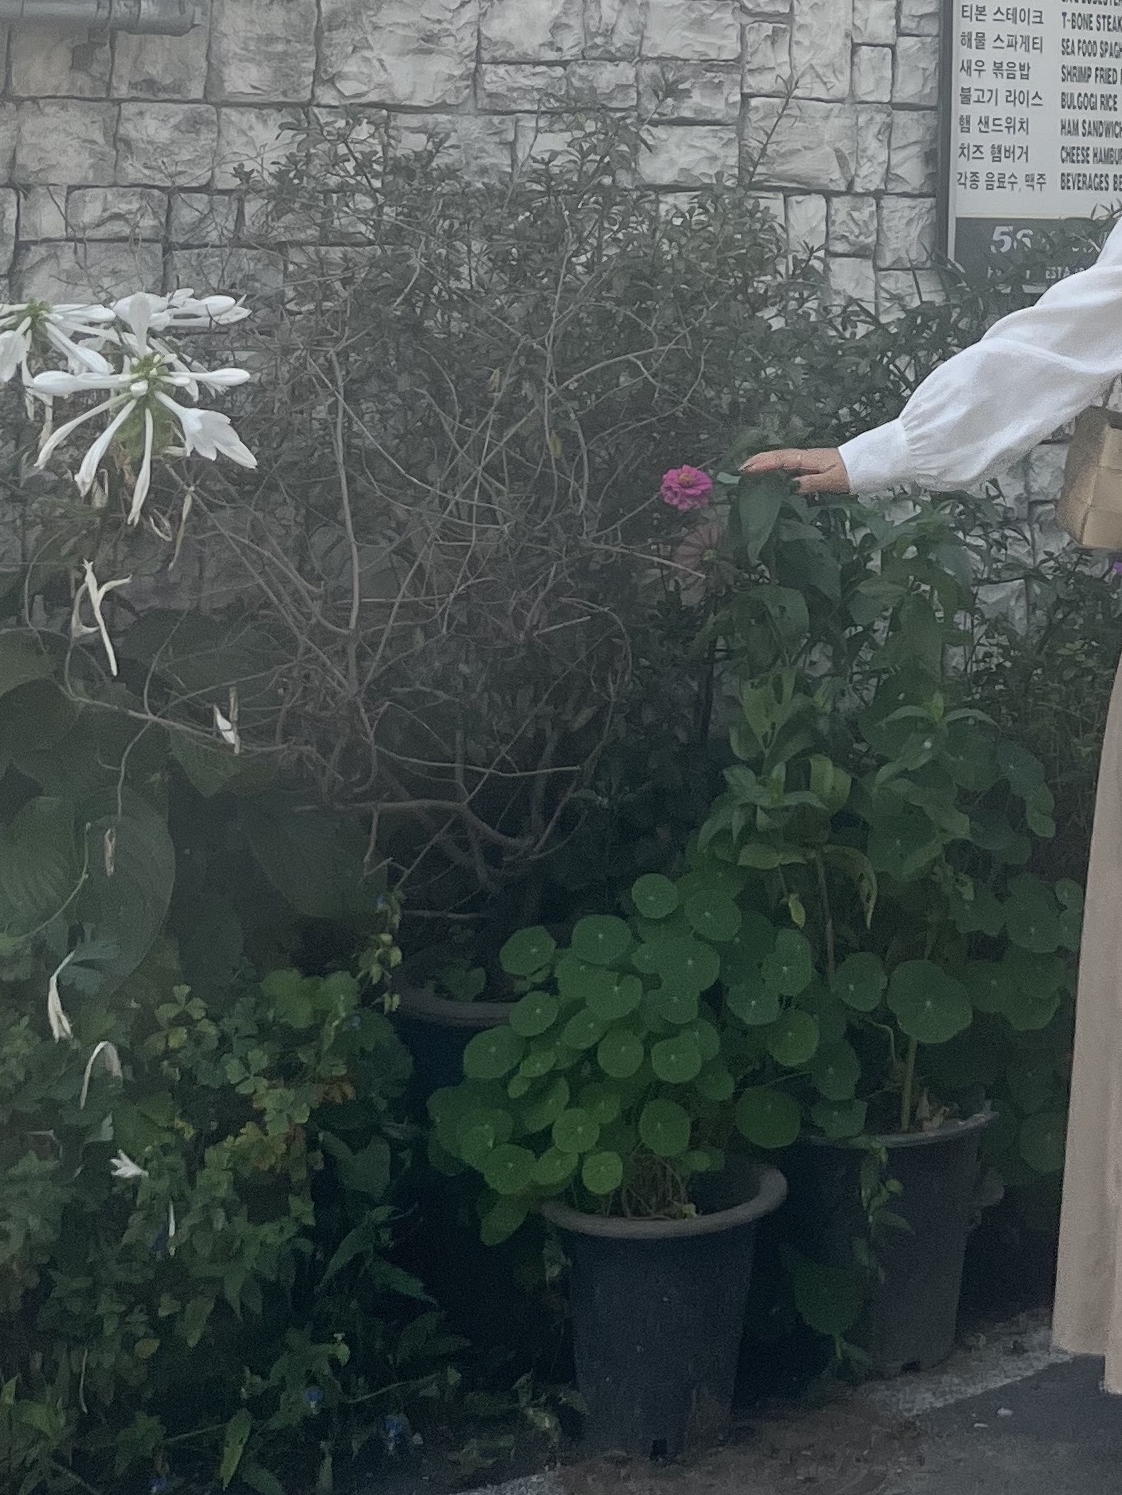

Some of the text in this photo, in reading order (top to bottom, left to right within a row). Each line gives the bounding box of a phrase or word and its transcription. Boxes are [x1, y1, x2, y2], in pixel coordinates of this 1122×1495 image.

[961, 4, 1044, 26] 티본 스테이크
[1062, 11, 1122, 33] T-BONE STEAK
[960, 31, 1043, 54] 해물 스파게티
[1061, 38, 1075, 56] SEA
[1078, 39, 1098, 58] FOOD
[960, 59, 1031, 80] 새우 볶음밥
[1061, 64, 1092, 83] SHRIMP
[1095, 66, 1118, 85] FRIED
[959, 86, 1043, 108] 불고기 라이스
[1061, 91, 1118, 111] BULGOGI RICE
[959, 114, 1029, 135] 햄 샌드위치
[1061, 118, 1080, 137] HAM
[958, 143, 1029, 163] 치즈 햄버거
[1061, 145, 1090, 164] CHEESE
[957, 171, 980, 190] 각종
[1025, 173, 1047, 192] 맥주
[1061, 172, 1110, 191] BEVERAGES
